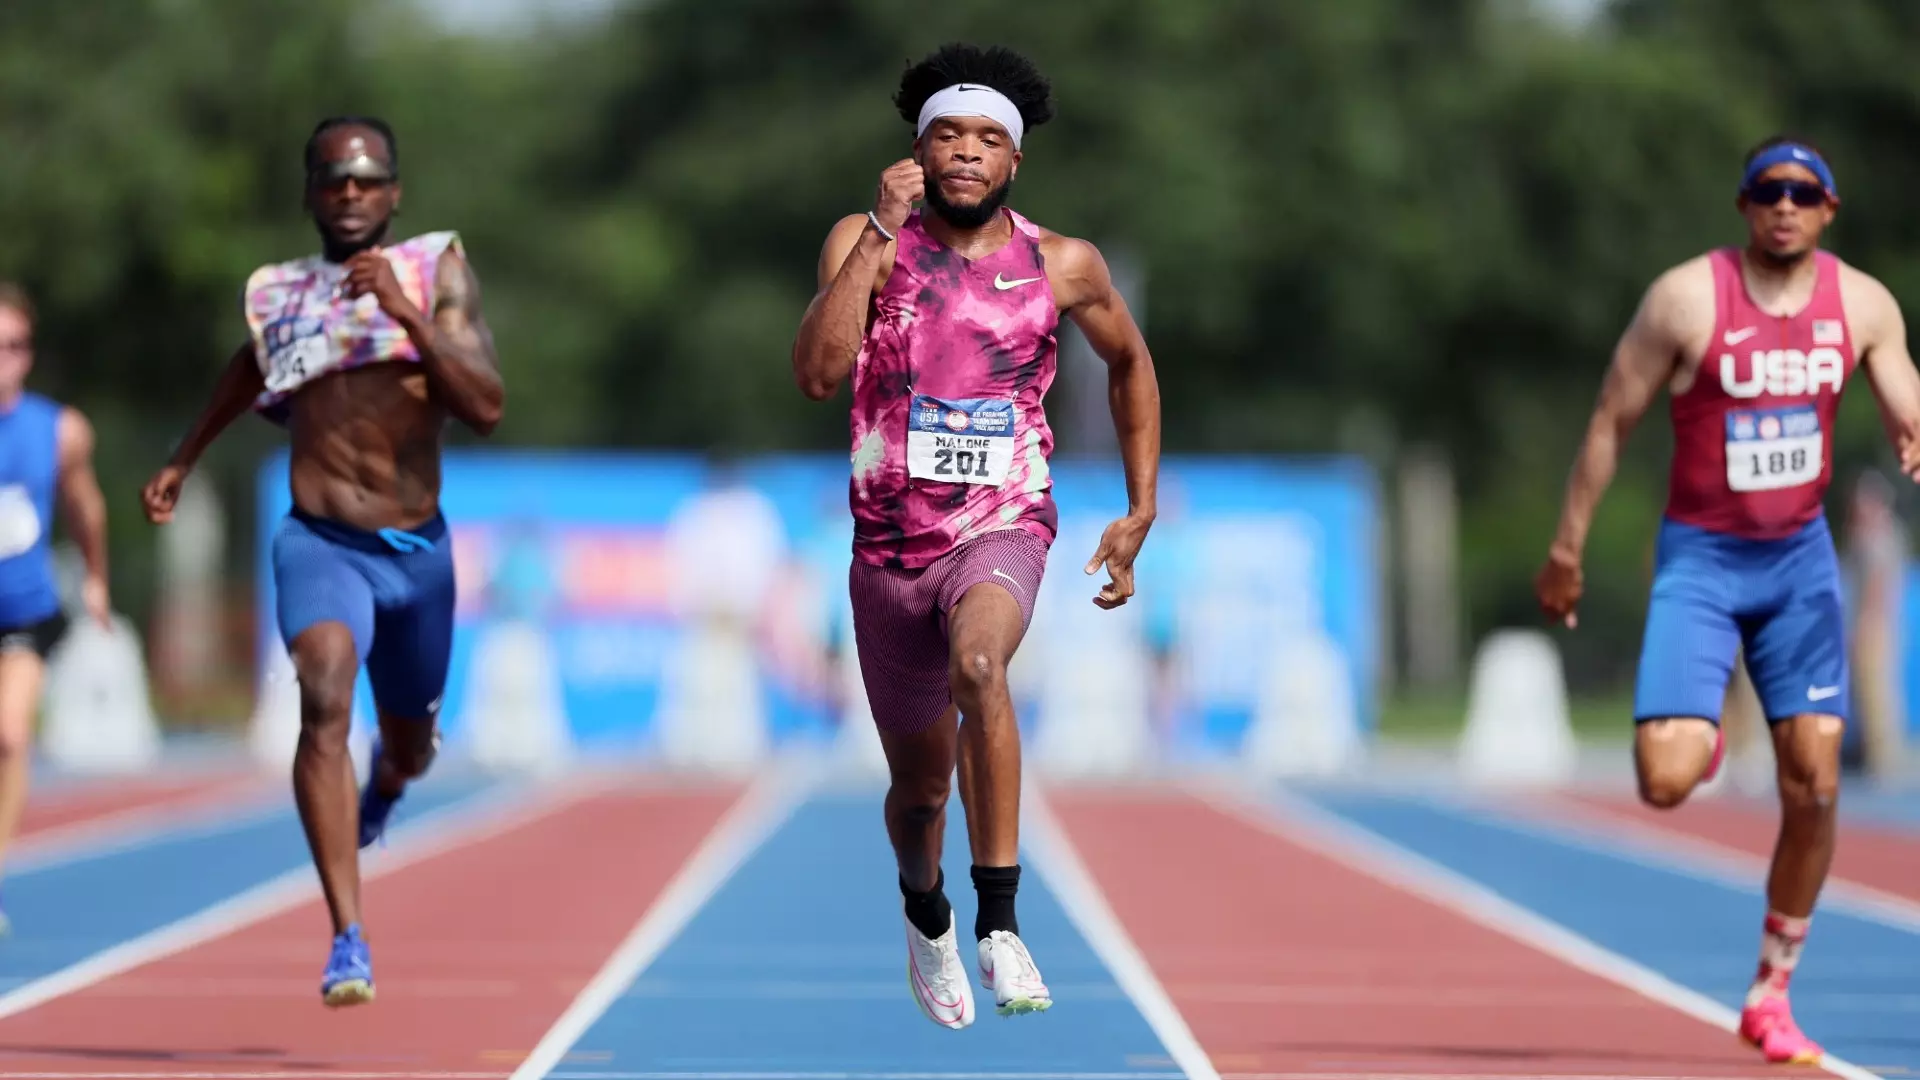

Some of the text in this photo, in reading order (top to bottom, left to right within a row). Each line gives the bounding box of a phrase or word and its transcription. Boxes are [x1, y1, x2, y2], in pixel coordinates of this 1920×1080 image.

[1720, 348, 1844, 398] USA
[920, 413, 939, 424] USA
[935, 436, 991, 449] MALONE
[934, 448, 990, 477] 201
[1751, 449, 1806, 476] 188
